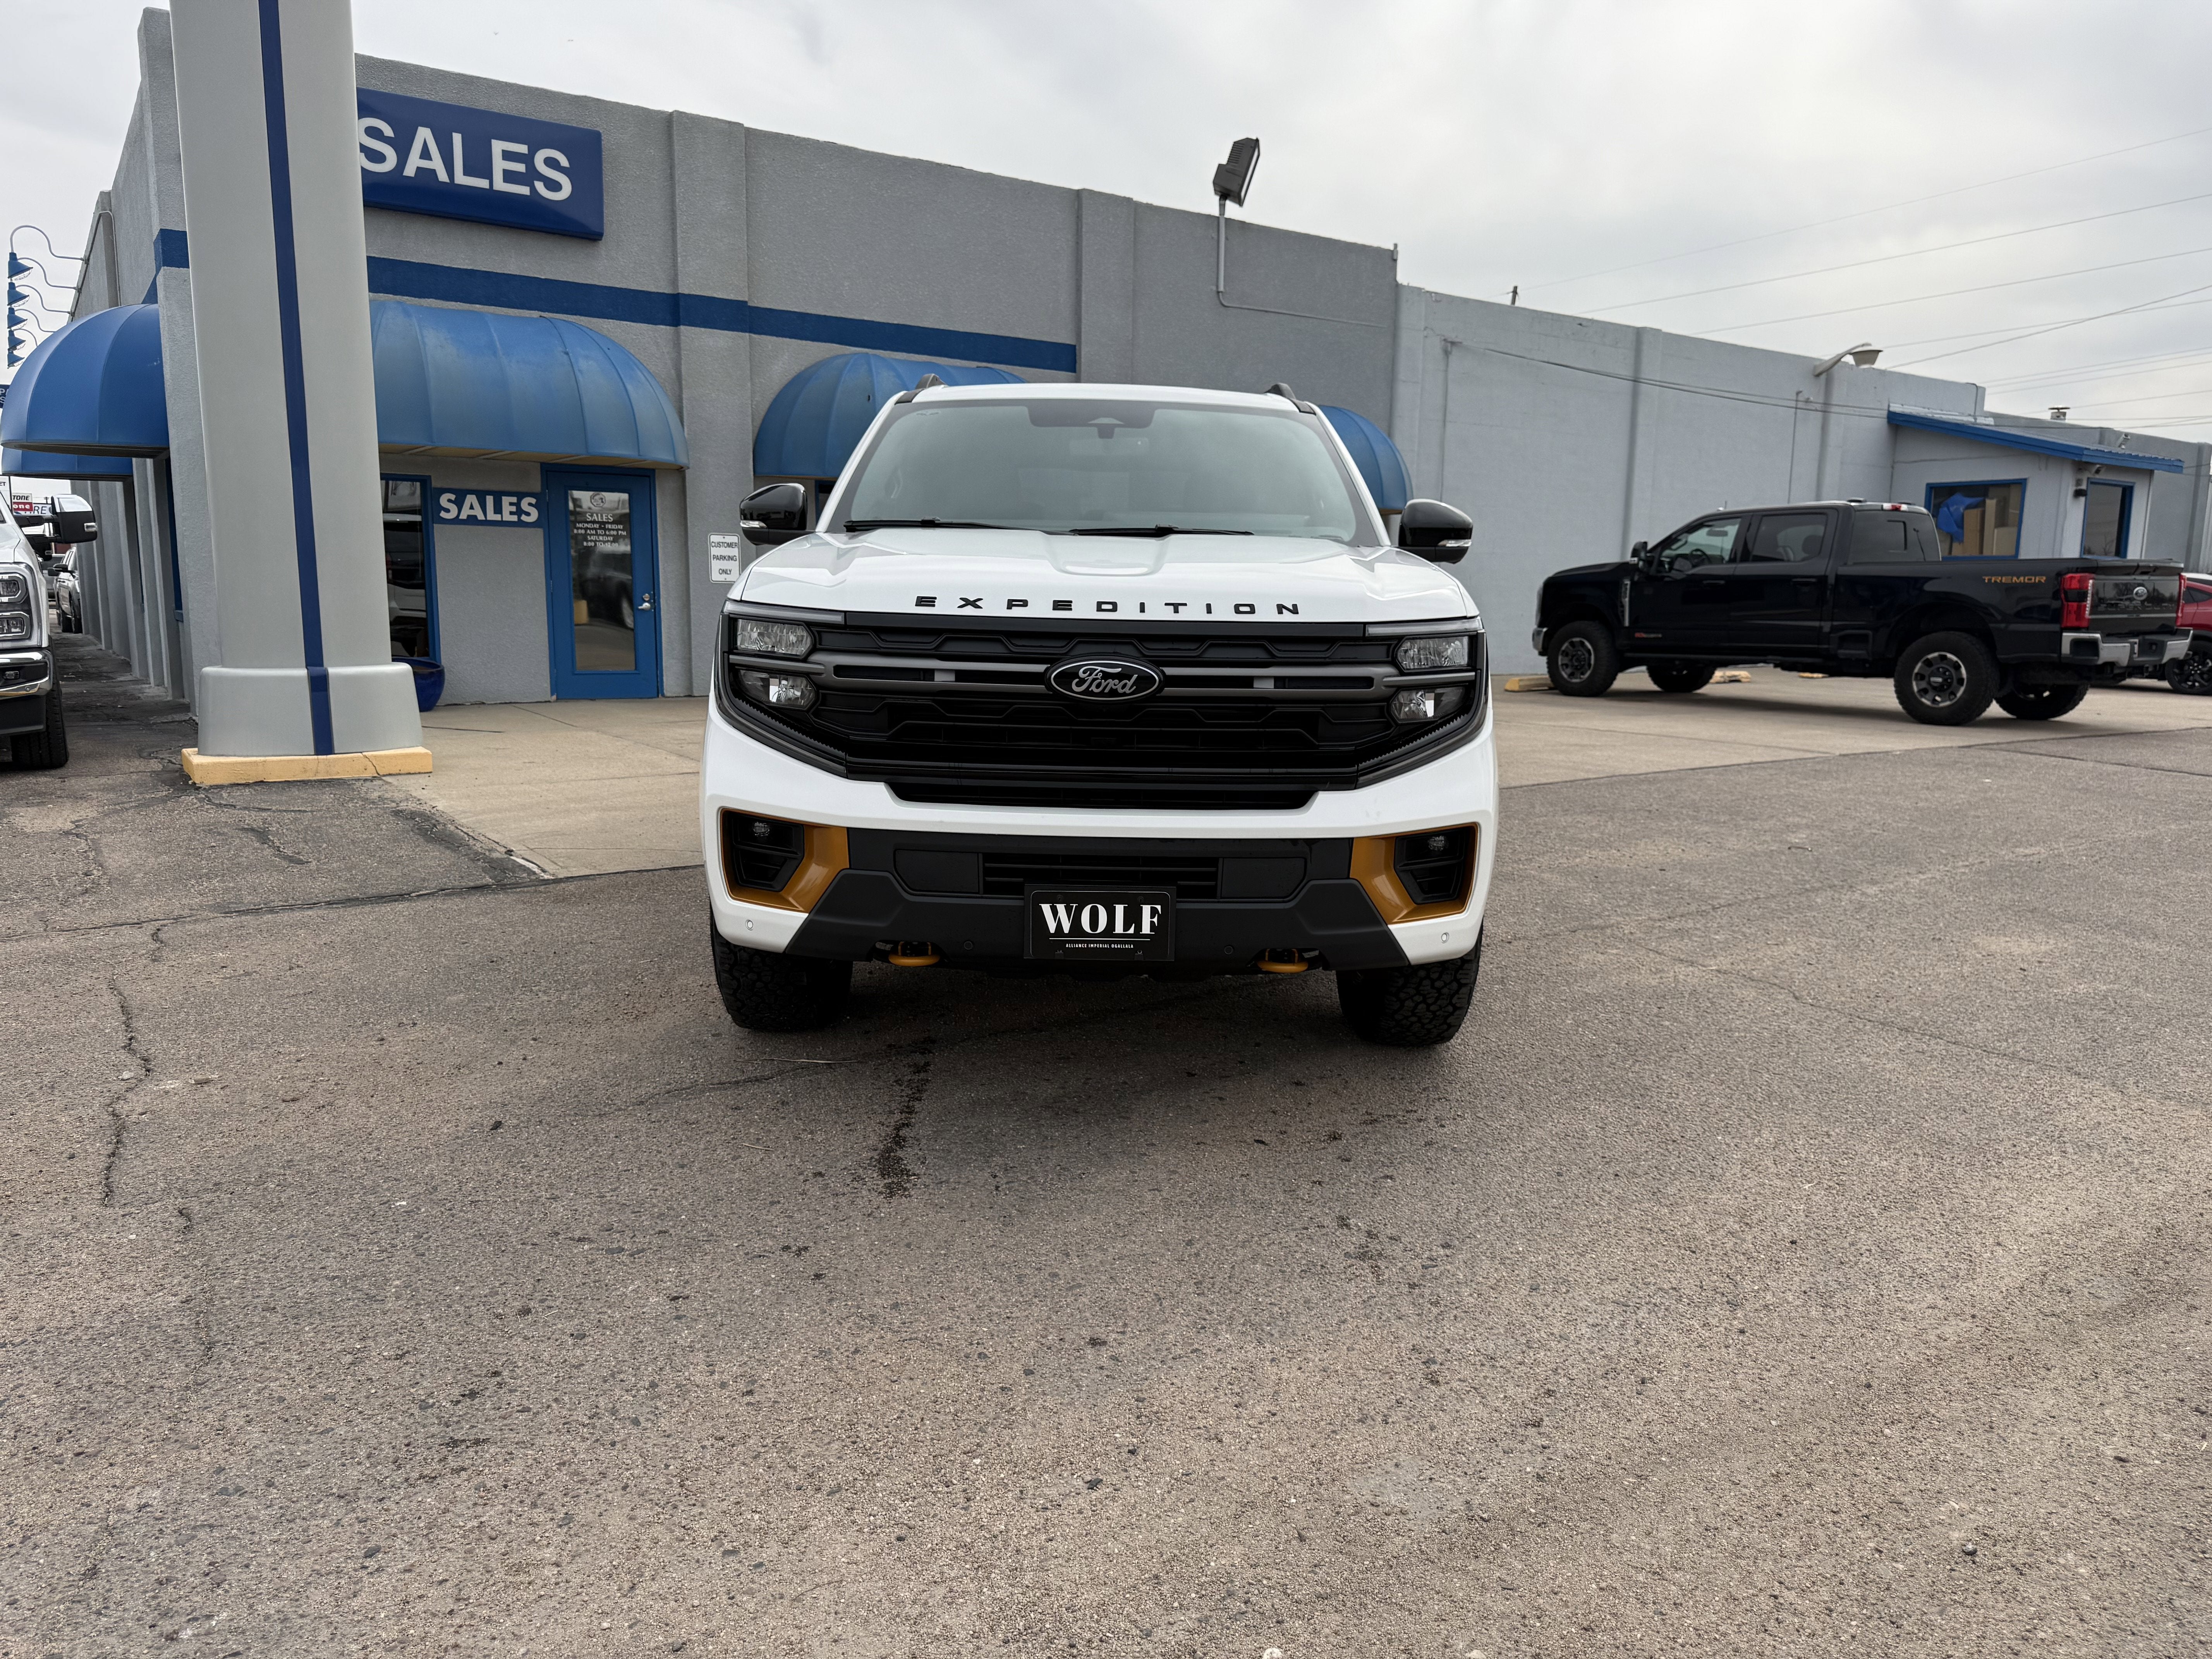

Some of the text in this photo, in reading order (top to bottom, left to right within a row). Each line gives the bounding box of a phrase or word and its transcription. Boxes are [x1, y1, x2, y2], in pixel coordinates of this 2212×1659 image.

[357, 117, 572, 201] SALES
[440, 493, 539, 522] SALES
[586, 513, 613, 522] SALES
[914, 596, 1300, 615] EXPEDITION
[1072, 666, 1138, 694] Ford
[1039, 903, 1161, 934] WOLF
